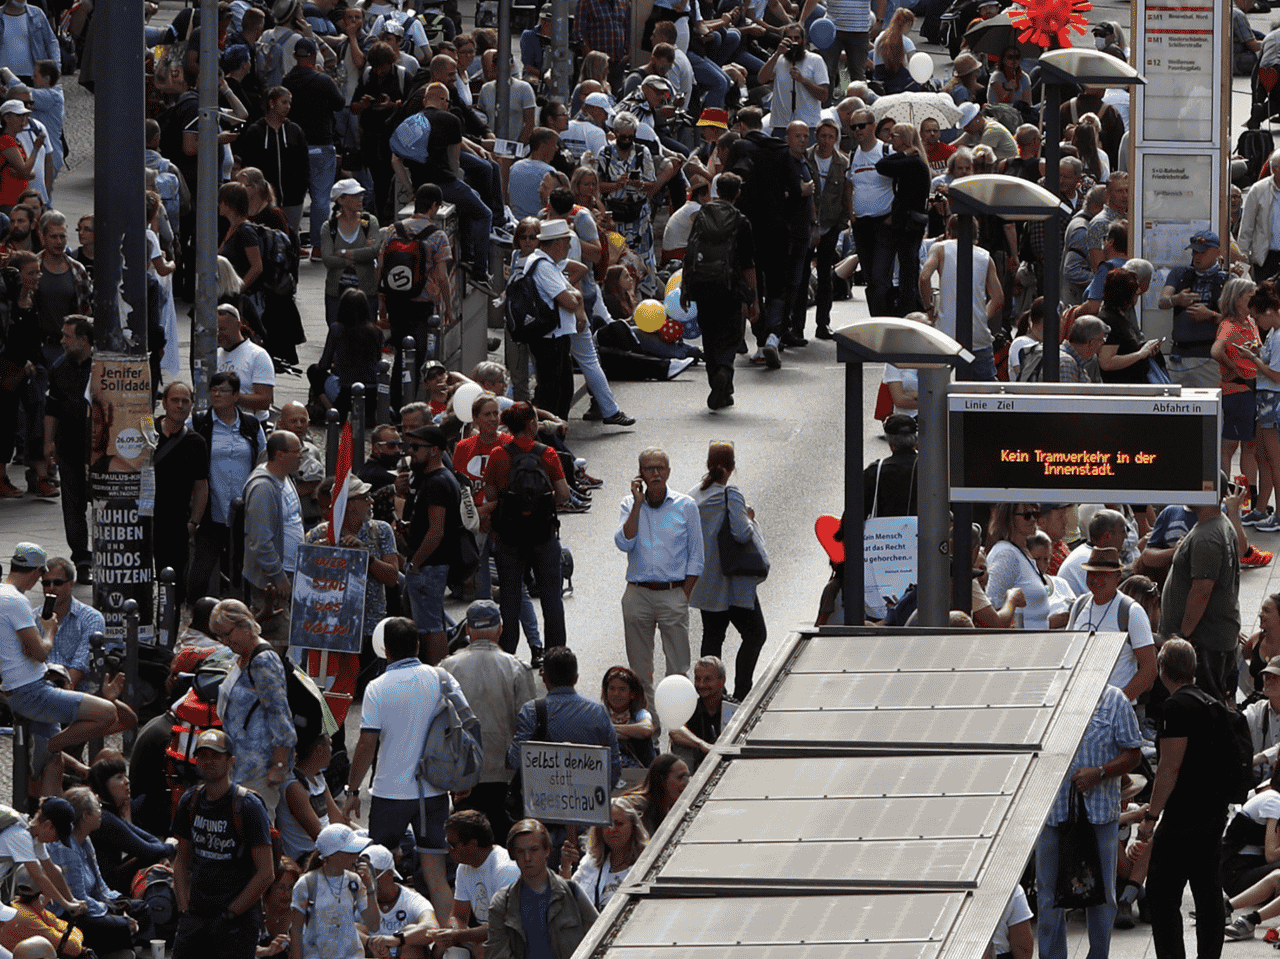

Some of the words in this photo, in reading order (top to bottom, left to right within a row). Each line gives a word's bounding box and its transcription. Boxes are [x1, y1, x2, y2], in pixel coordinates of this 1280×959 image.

[101, 366, 143, 381] Jenifer
[964, 400, 987, 409] Linie
[996, 400, 1014, 410] Ziel
[1152, 402, 1191, 413] Abfahrt
[1192, 403, 1202, 413] in
[1000, 448, 1029, 462] Kein
[1034, 448, 1111, 463] Tramverkehr
[1116, 450, 1130, 463] in
[1134, 450, 1156, 464] der
[1043, 462, 1115, 476] Innenstadt.
[96, 509, 139, 524] RUHIG
[875, 532, 903, 540] Mensch
[872, 543, 884, 551] das
[885, 543, 906, 551] Recht
[525, 751, 560, 770] Selbst
[564, 752, 603, 773] denken
